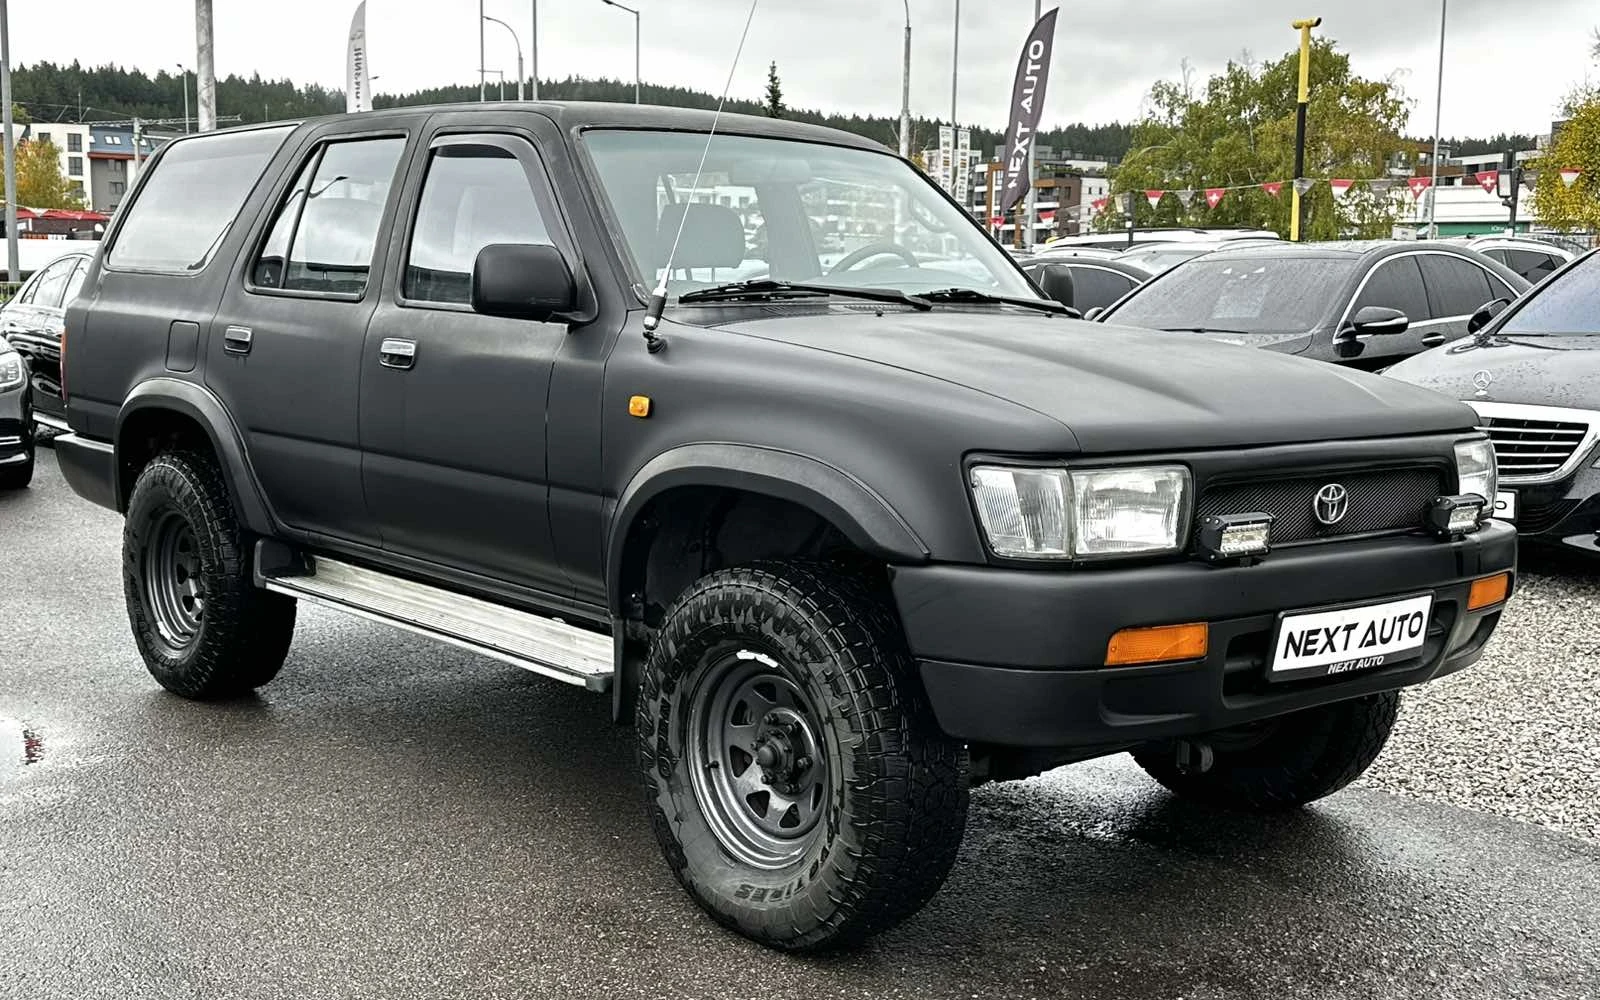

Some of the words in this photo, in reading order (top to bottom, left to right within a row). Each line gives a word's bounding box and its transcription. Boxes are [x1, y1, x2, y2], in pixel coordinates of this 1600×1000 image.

[1008, 121, 1030, 189] NEXT
[1021, 40, 1044, 114] AUTO
[1283, 622, 1360, 659] NEXT
[1358, 610, 1424, 649] AUTO
[1327, 660, 1357, 675] NEXT
[1356, 655, 1385, 670] AUTO
[734, 878, 806, 903] TIRES
